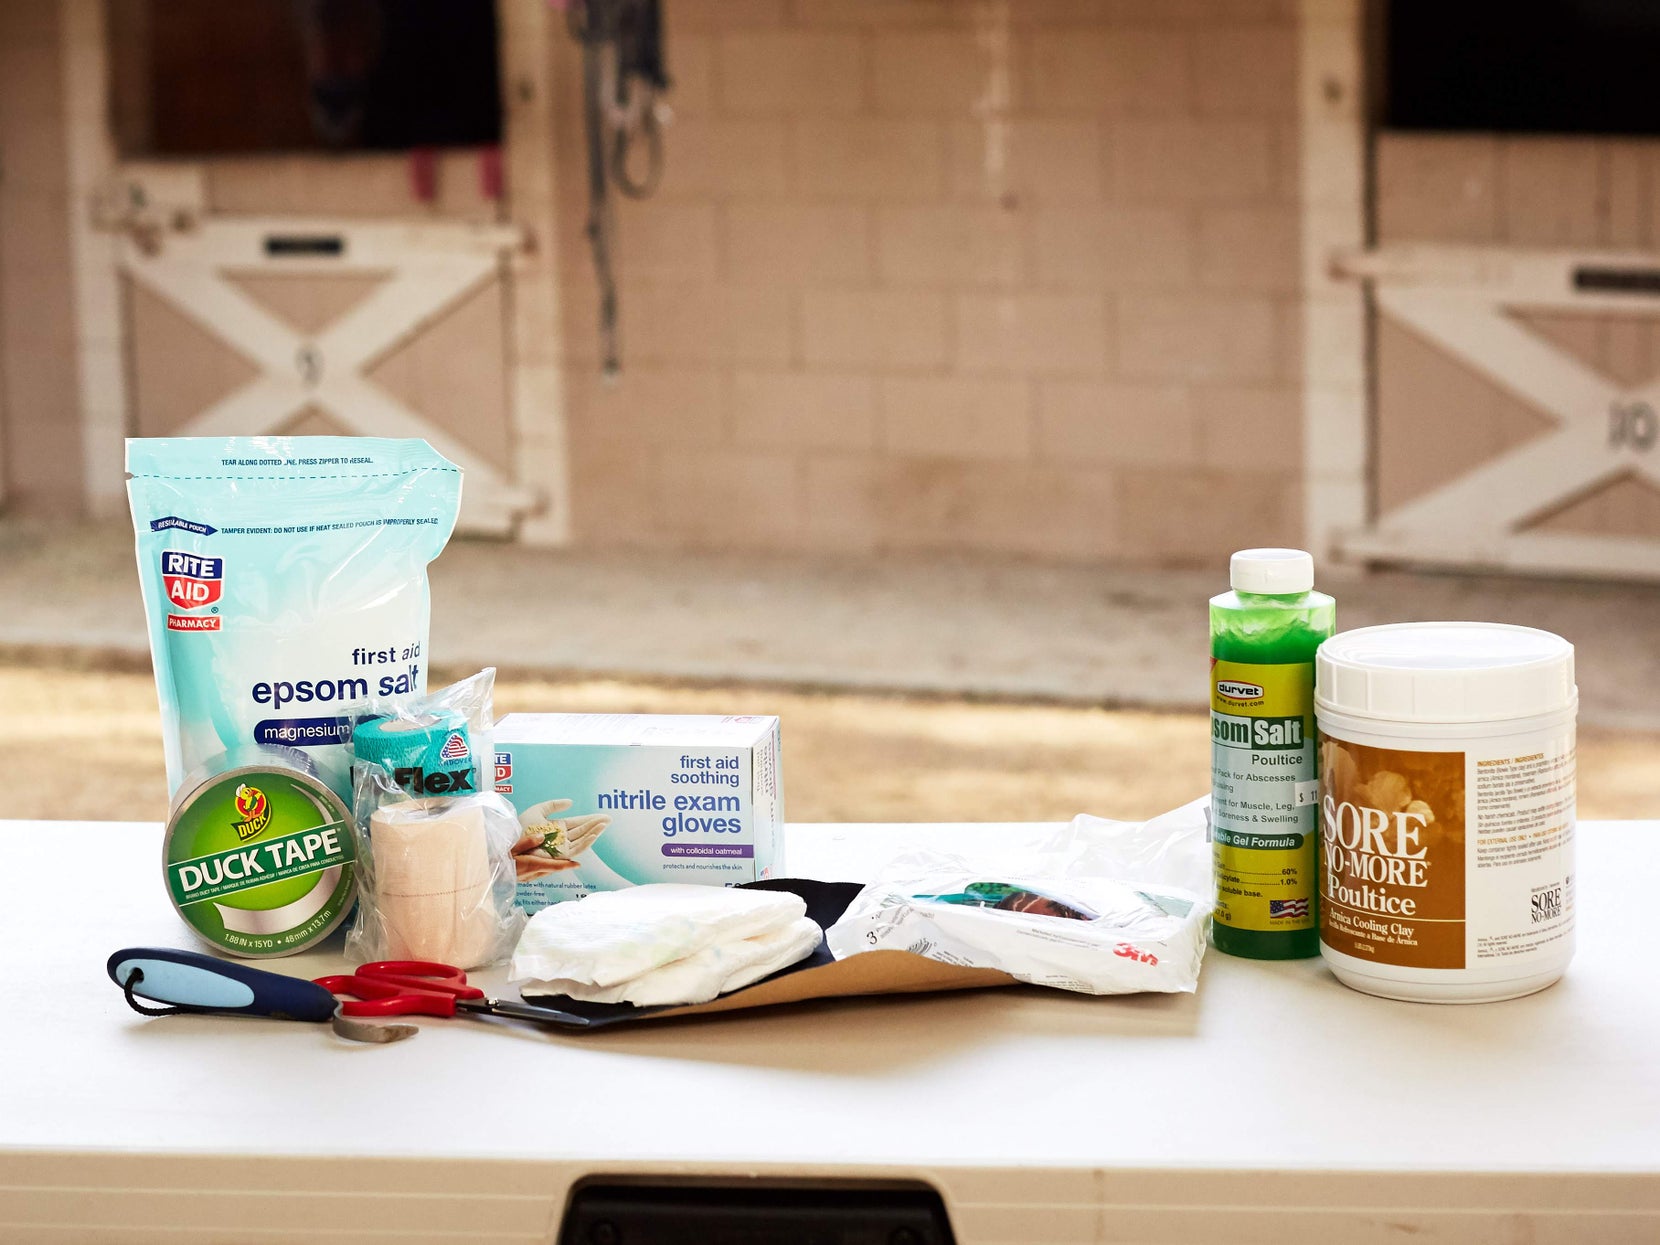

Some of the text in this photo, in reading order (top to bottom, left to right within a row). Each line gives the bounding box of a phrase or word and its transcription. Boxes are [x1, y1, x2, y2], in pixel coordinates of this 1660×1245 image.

[188, 524, 207, 532] POUCH
[168, 554, 214, 576] RITE
[171, 580, 210, 601] AID
[169, 618, 217, 628] PHARMACY
[352, 641, 421, 665] first aid
[252, 664, 419, 710] epsom salt
[1218, 684, 1259, 696] durvet
[264, 723, 350, 741] magnesium
[1212, 717, 1302, 746] som Salt
[495, 754, 508, 764] TE
[680, 755, 739, 770] first aid
[1252, 754, 1303, 766] Poultice
[350, 766, 473, 794] Flex
[670, 771, 740, 788] soothing
[1233, 772, 1244, 780] for
[1246, 774, 1296, 782] Abscesses
[598, 789, 740, 812] nitrile exam
[1228, 799, 1238, 807] for
[1240, 802, 1274, 811] Muscle,
[662, 812, 742, 837] gloves
[1218, 808, 1250, 822] Soreness
[1260, 815, 1299, 824] Swelling
[238, 814, 267, 838] DUCK
[1323, 794, 1428, 860] SORE
[1232, 835, 1249, 846] Gel
[1251, 837, 1296, 847] Formula
[178, 828, 342, 892] DUCK TAPE
[686, 847, 714, 855] colloidal
[715, 848, 743, 856] oatmeal
[1324, 840, 1428, 888] NO-MORE
[1244, 890, 1263, 898] base.
[1327, 873, 1416, 916] Poultice
[1530, 888, 1562, 914] SORE
[1330, 907, 1414, 938] Arnica Cooling Clay
[1531, 905, 1562, 924] NO-MORE
[1372, 932, 1386, 942] Base
[1386, 936, 1395, 944] de
